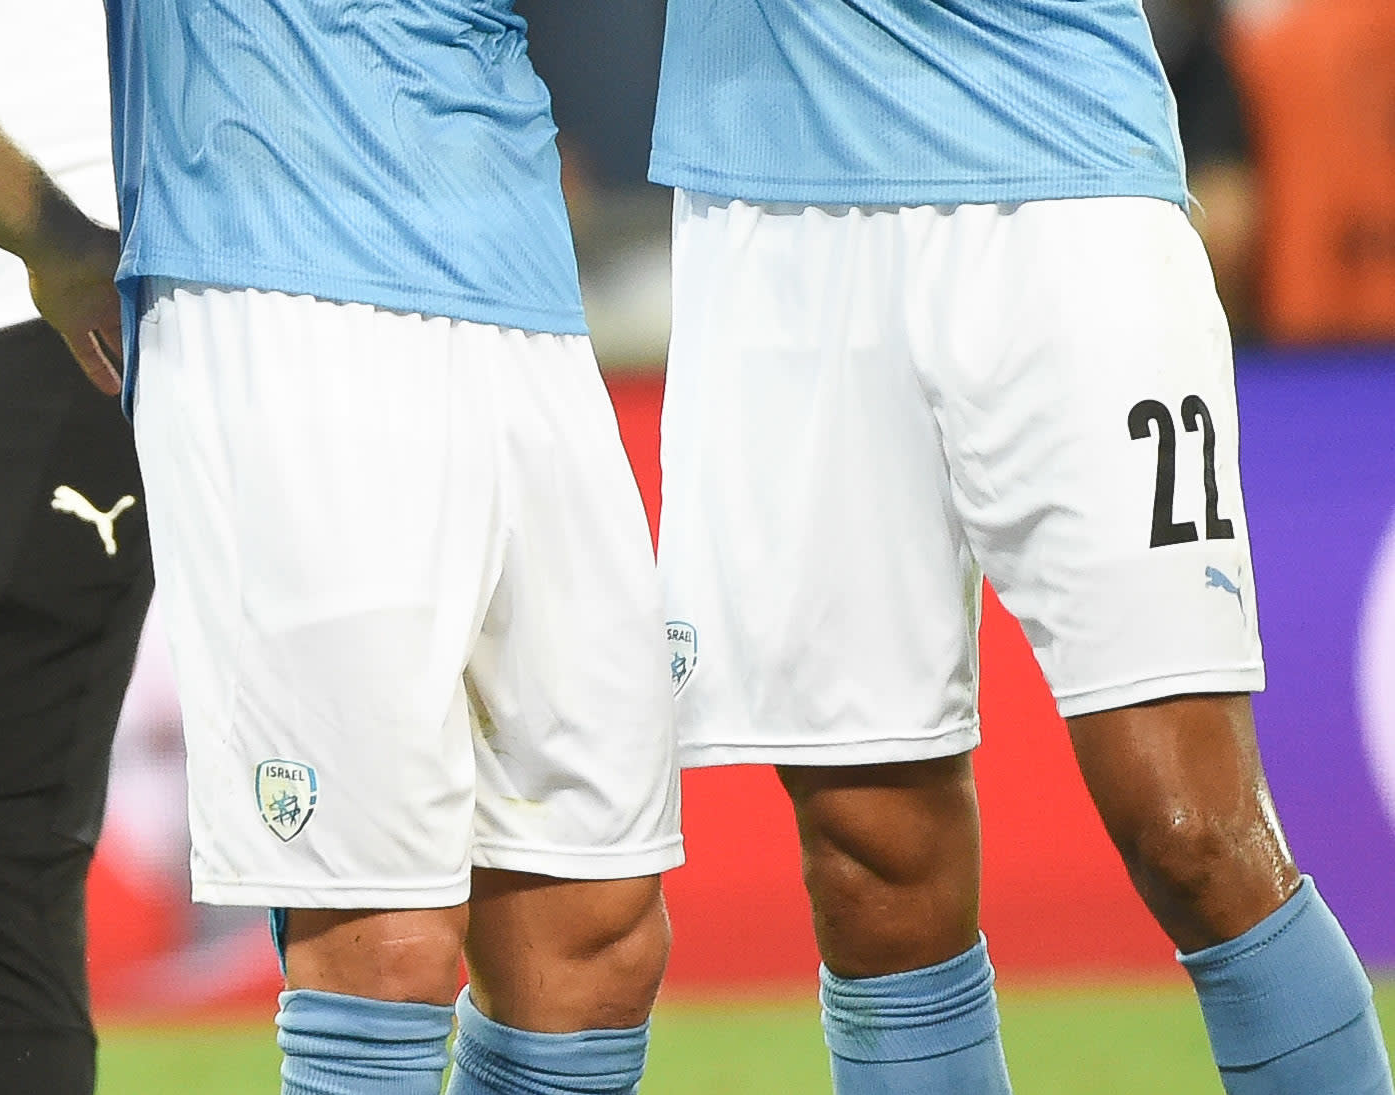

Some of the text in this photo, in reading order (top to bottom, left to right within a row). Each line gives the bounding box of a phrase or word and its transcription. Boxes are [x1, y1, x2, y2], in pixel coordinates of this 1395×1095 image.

[1126, 394, 1235, 549] 22
[666, 628, 692, 643] SRAEL
[265, 766, 305, 782] ISRAEL
